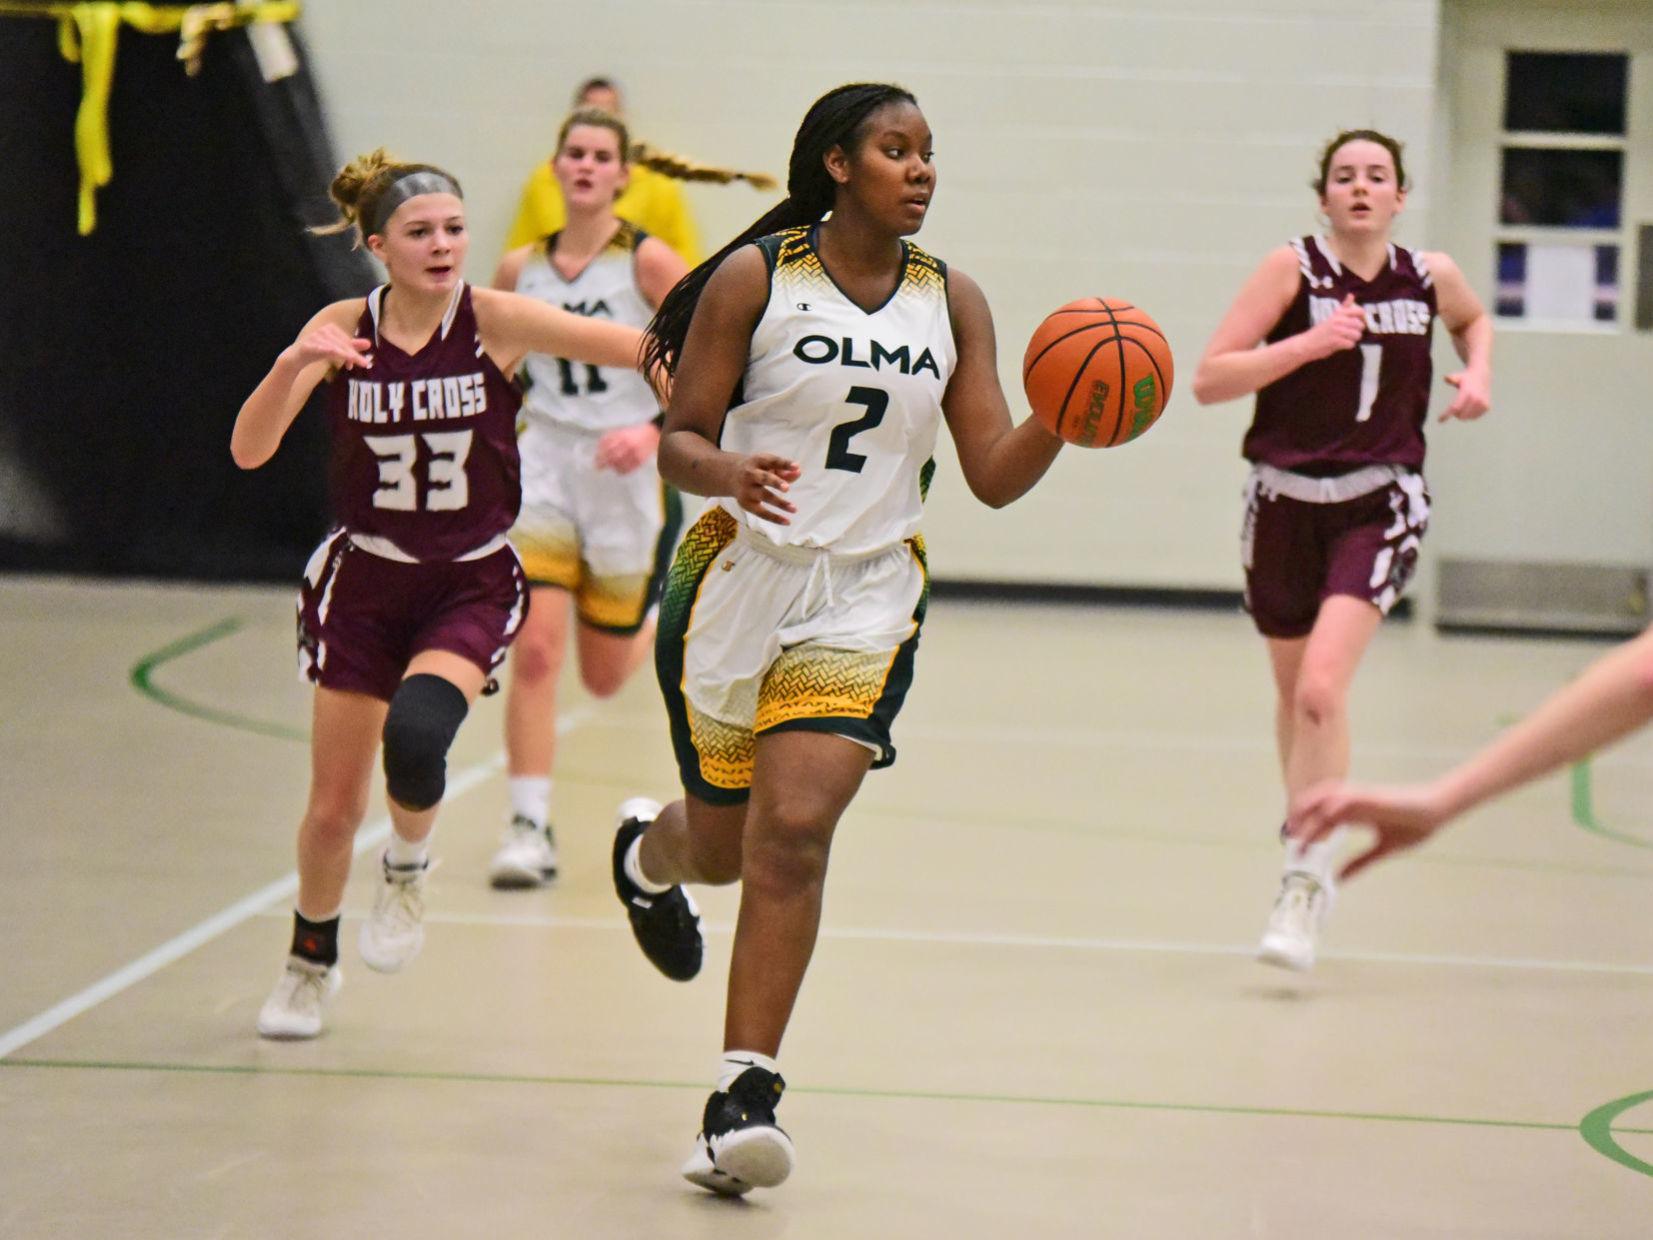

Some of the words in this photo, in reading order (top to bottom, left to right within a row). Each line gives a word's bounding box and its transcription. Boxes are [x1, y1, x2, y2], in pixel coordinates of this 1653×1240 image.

[1364, 299, 1430, 335] CROSS
[793, 335, 941, 380] OLMA
[1355, 344, 1383, 422] 1
[348, 378, 405, 424] HOLY
[411, 372, 487, 421] CROSS
[825, 386, 889, 473] 2
[363, 429, 473, 512] 33
